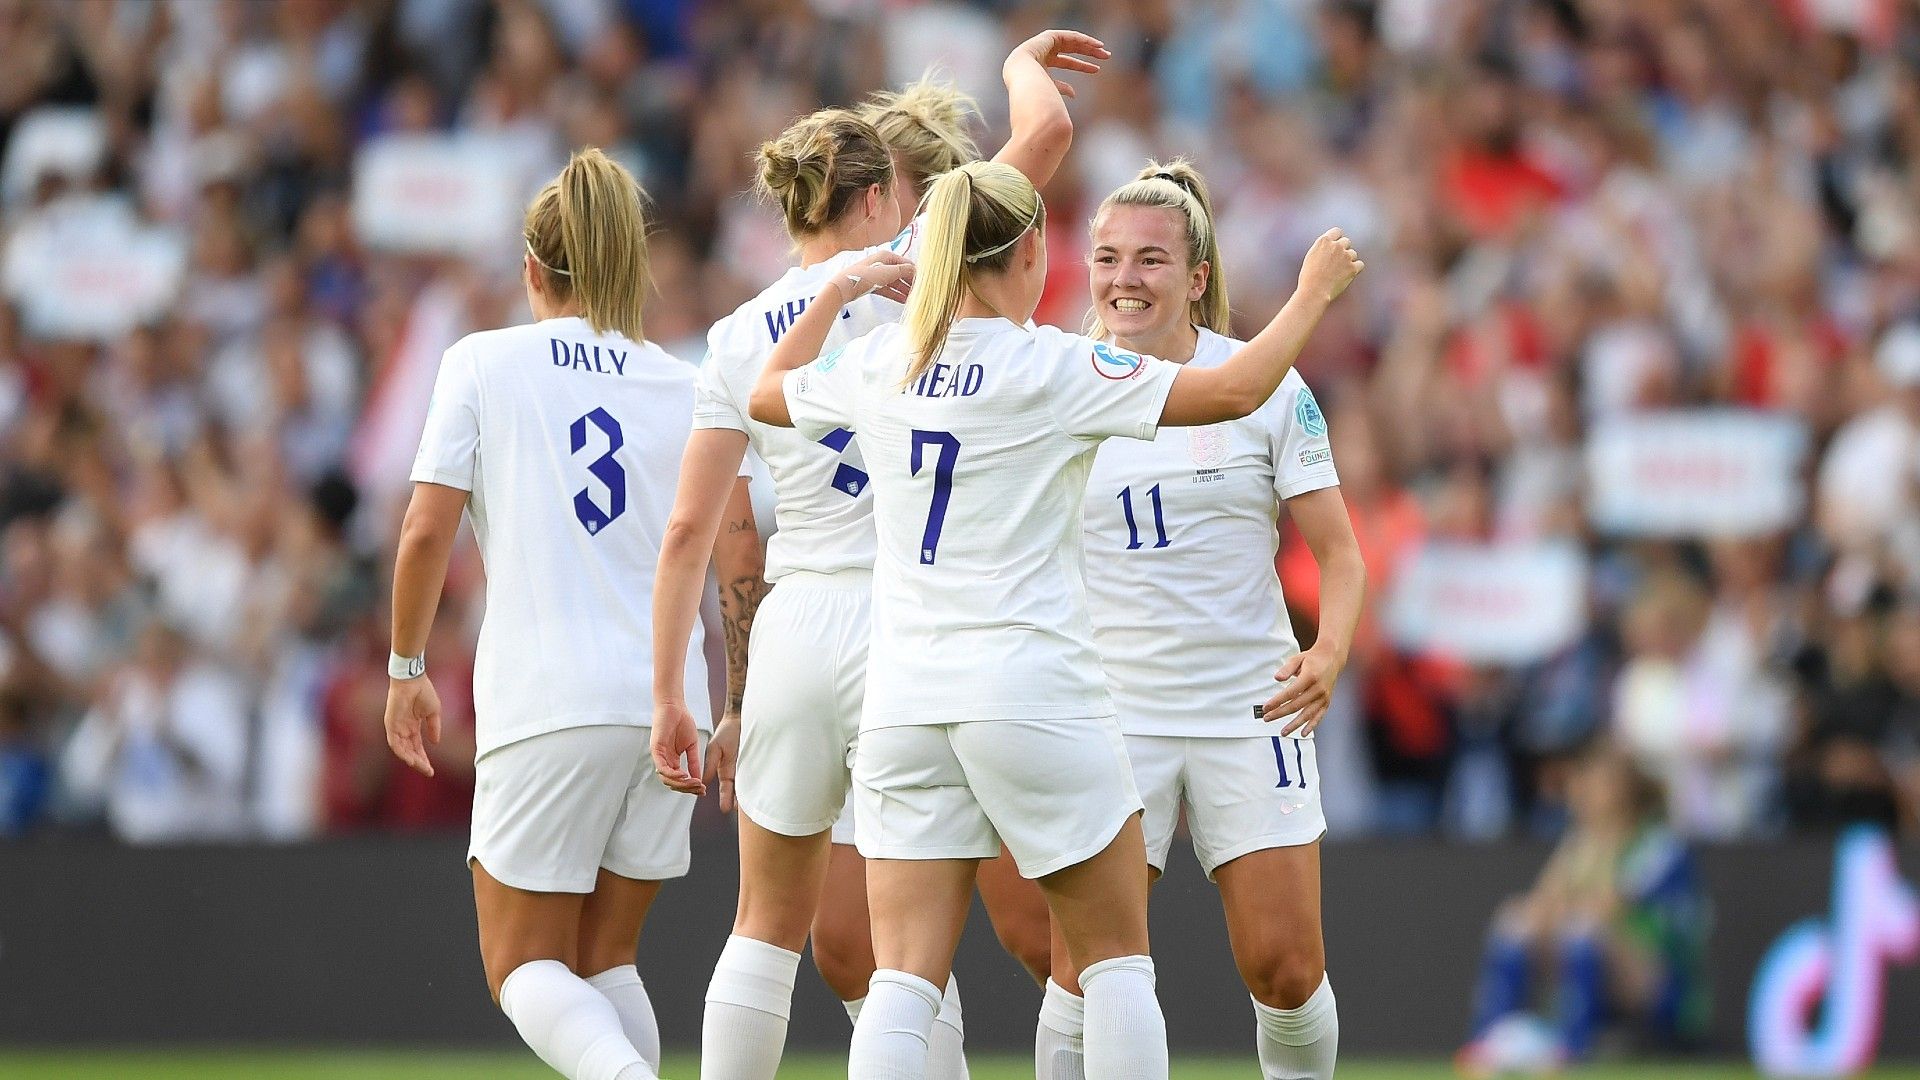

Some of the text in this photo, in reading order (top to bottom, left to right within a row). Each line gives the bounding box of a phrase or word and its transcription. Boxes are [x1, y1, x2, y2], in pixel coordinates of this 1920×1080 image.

[550, 338, 628, 376] DALY
[569, 406, 627, 537] 3
[910, 428, 961, 565] 7
[1116, 482, 1173, 550] 11
[1270, 736, 1307, 789] 11
